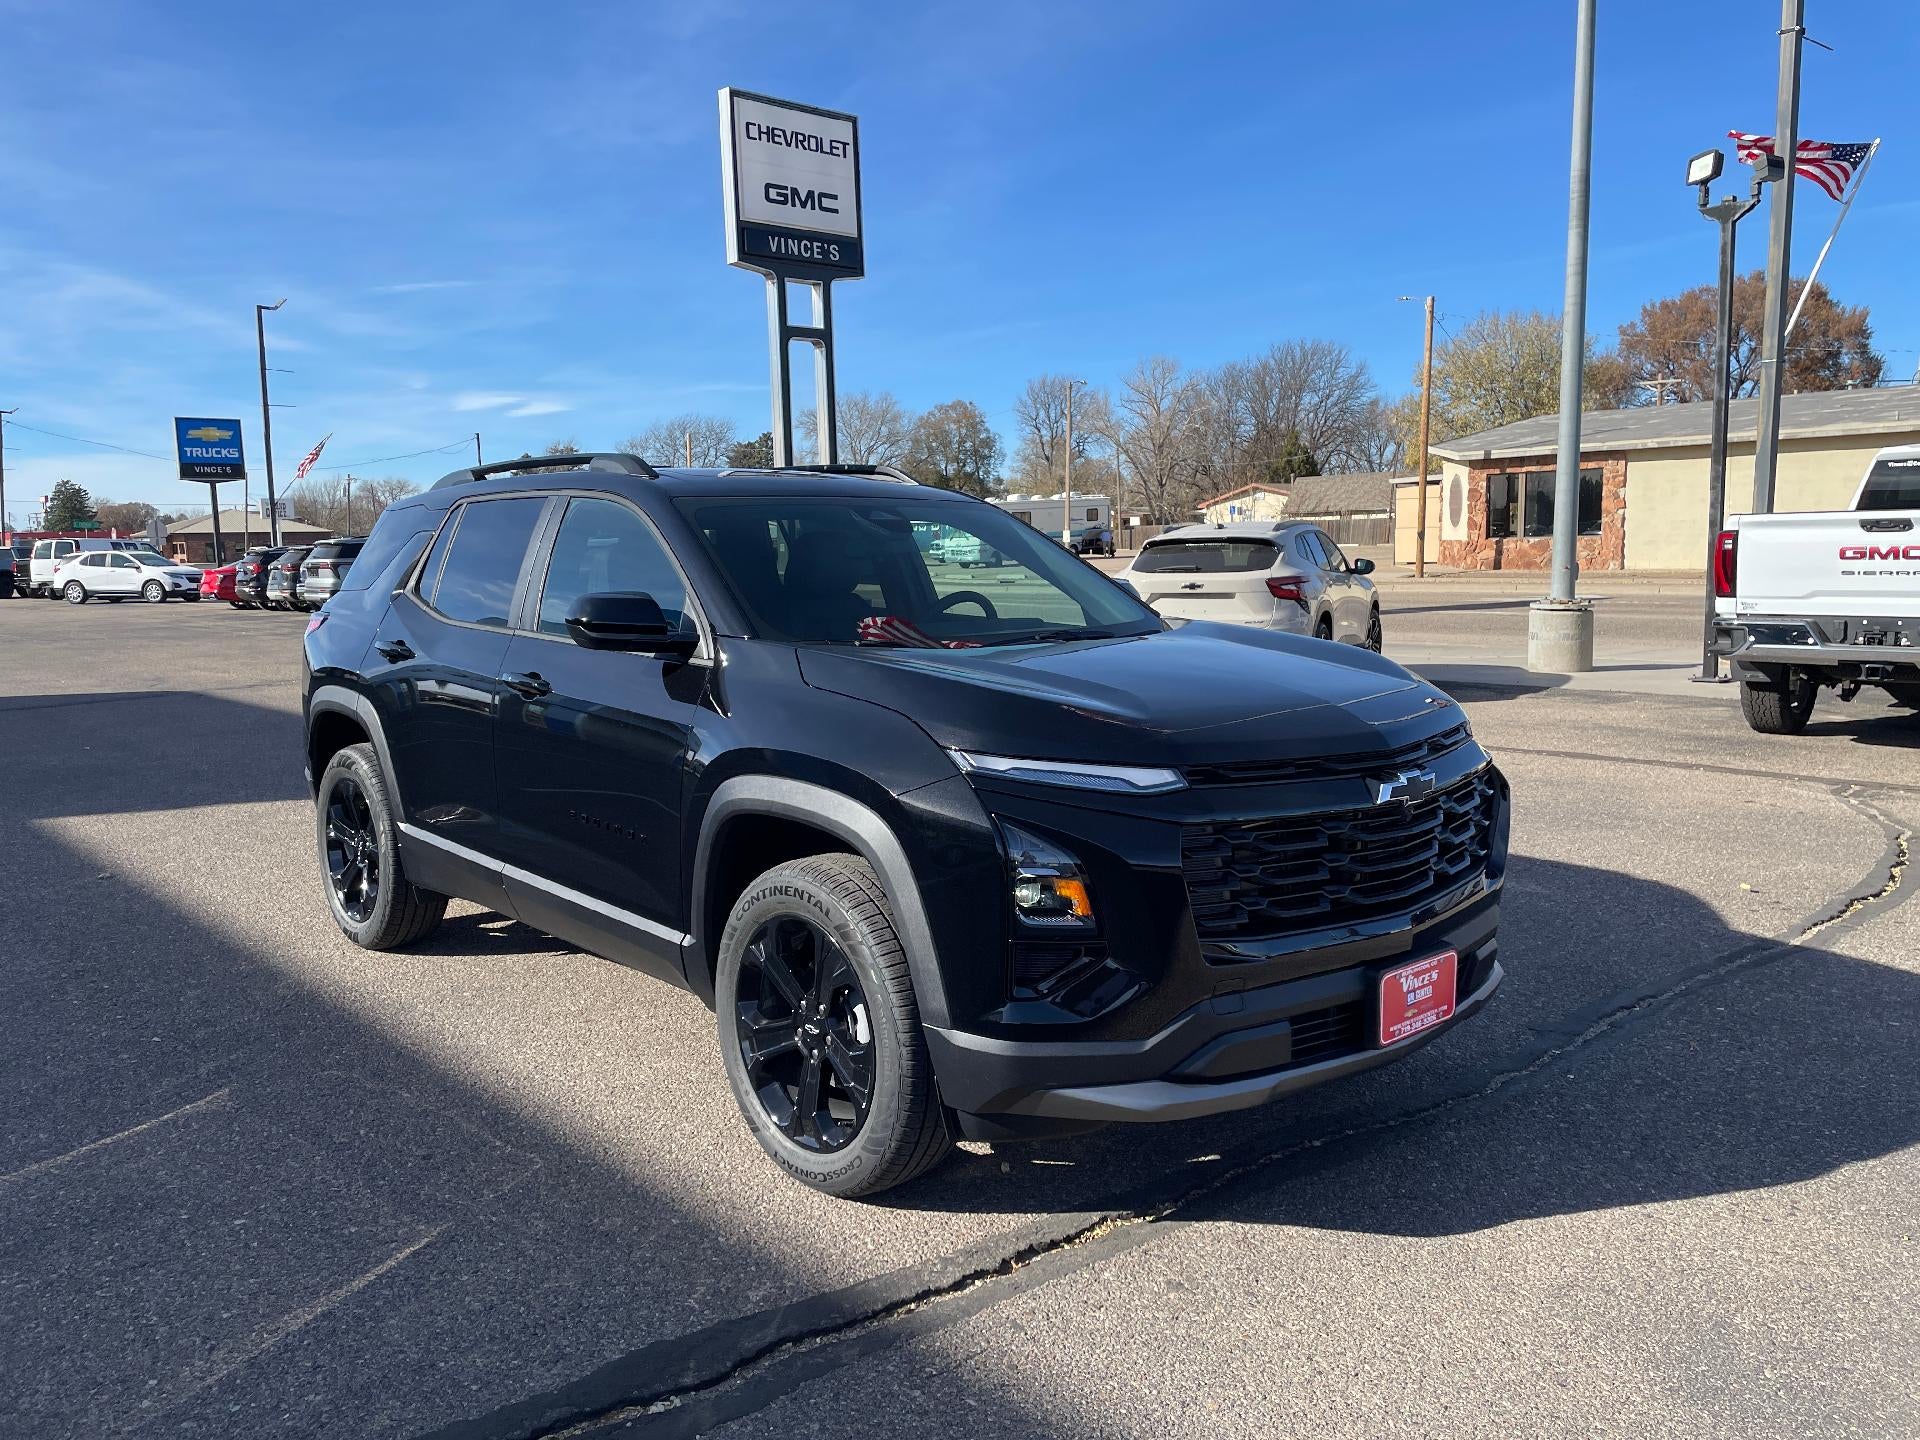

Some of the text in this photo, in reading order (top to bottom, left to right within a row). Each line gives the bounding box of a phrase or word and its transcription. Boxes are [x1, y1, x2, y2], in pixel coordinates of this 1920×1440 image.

[745, 121, 850, 159] CHEVROLET
[763, 182, 839, 214] GMC
[768, 235, 840, 261] VINCE'S
[184, 447, 239, 458] TRUCKS
[736, 885, 832, 922] CONTINENTAL
[1400, 969, 1439, 992] VINCE'S
